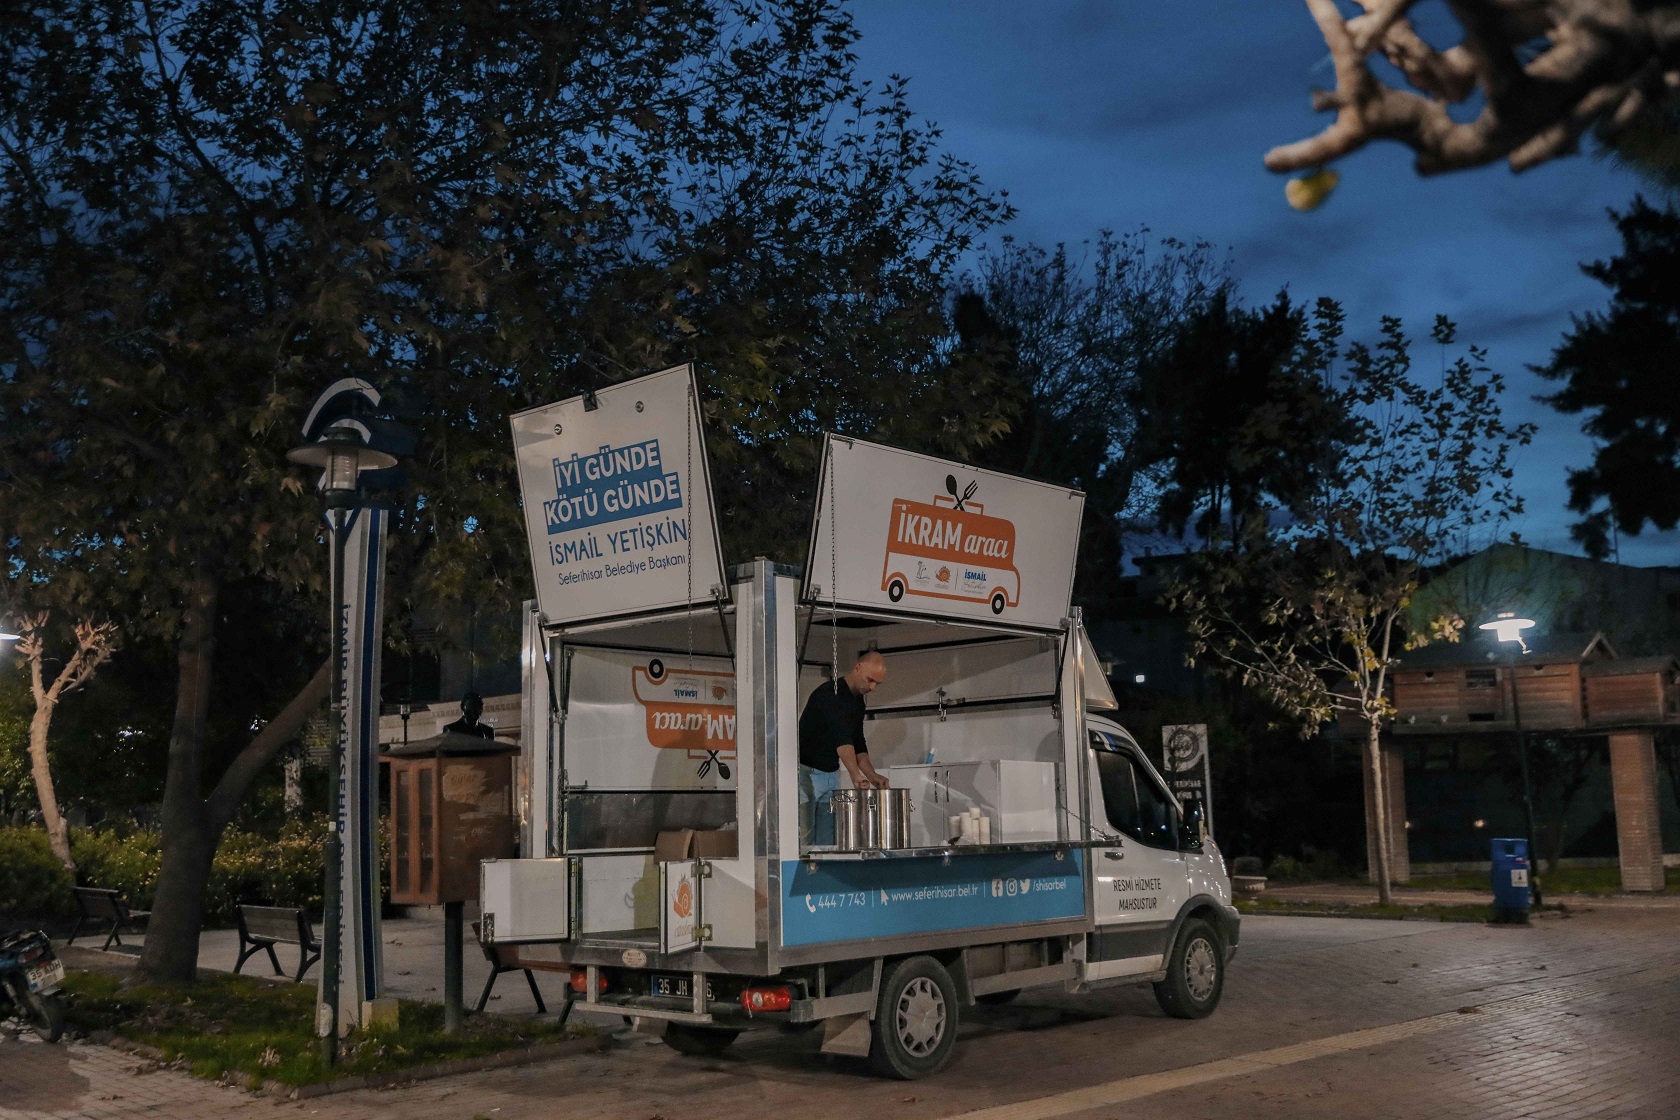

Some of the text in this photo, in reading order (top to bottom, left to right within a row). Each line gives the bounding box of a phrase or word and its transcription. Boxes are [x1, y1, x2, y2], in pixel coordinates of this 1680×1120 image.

[554, 442, 659, 489] İYİ GÜNDE
[545, 474, 680, 526] KÖTÜ GÜNDE
[898, 504, 1009, 559] İKRAM aracı
[549, 516, 688, 566] İSMAİL YETİŞKİN
[558, 554, 686, 586] Seferihisar Belediye Başkanı
[965, 569, 987, 581] İSMAİL
[651, 711, 703, 731] aracı
[1113, 876, 1161, 891] RESMİ HİZMETE
[818, 892, 865, 908] 444 7 743
[891, 885, 979, 902] www.seferihisar.bel.tr
[1119, 897, 1157, 910] MAHSUSTUR
[658, 979, 670, 994] 35
[676, 980, 688, 996] JH
